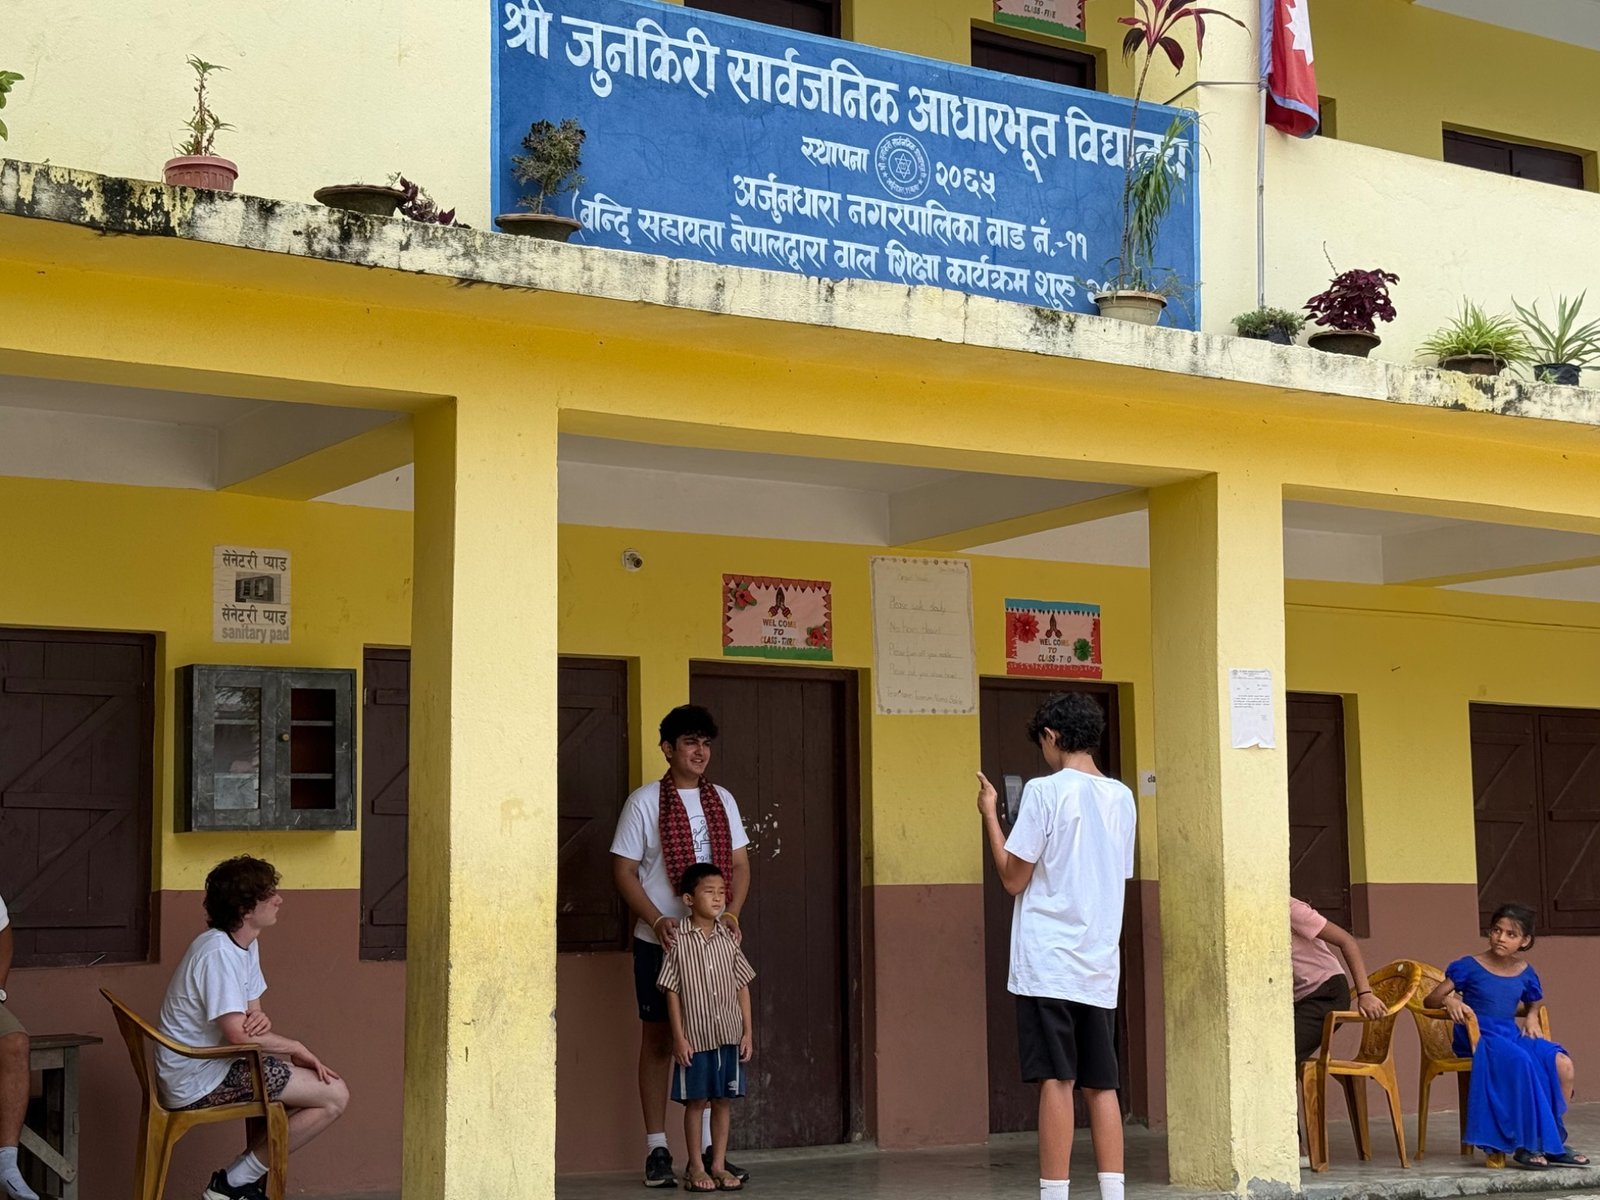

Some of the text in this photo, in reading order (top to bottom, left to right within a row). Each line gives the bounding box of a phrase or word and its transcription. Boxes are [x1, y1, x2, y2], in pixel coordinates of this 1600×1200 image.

[503, 0, 553, 59] श्री
[561, 17, 720, 98] जुनकिरी
[726, 47, 900, 126] सार्वजनिक
[908, 86, 1060, 184] आधारभूत
[800, 136, 870, 173] स्थापना
[935, 161, 996, 201] २०६५
[733, 172, 842, 227] अर्जुनधारा
[847, 194, 981, 246] नगरपालिका
[638, 208, 726, 256] सहायता
[885, 239, 941, 285] शिक्षा
[946, 255, 1030, 296] कार्यक्रम
[222, 549, 288, 571] सेनेटरी प्याड
[222, 604, 288, 625] सेनेटरी प्याड
[222, 623, 290, 643] sanitary pad
[773, 628, 784, 636] TO
[1048, 646, 1058, 654] TO
